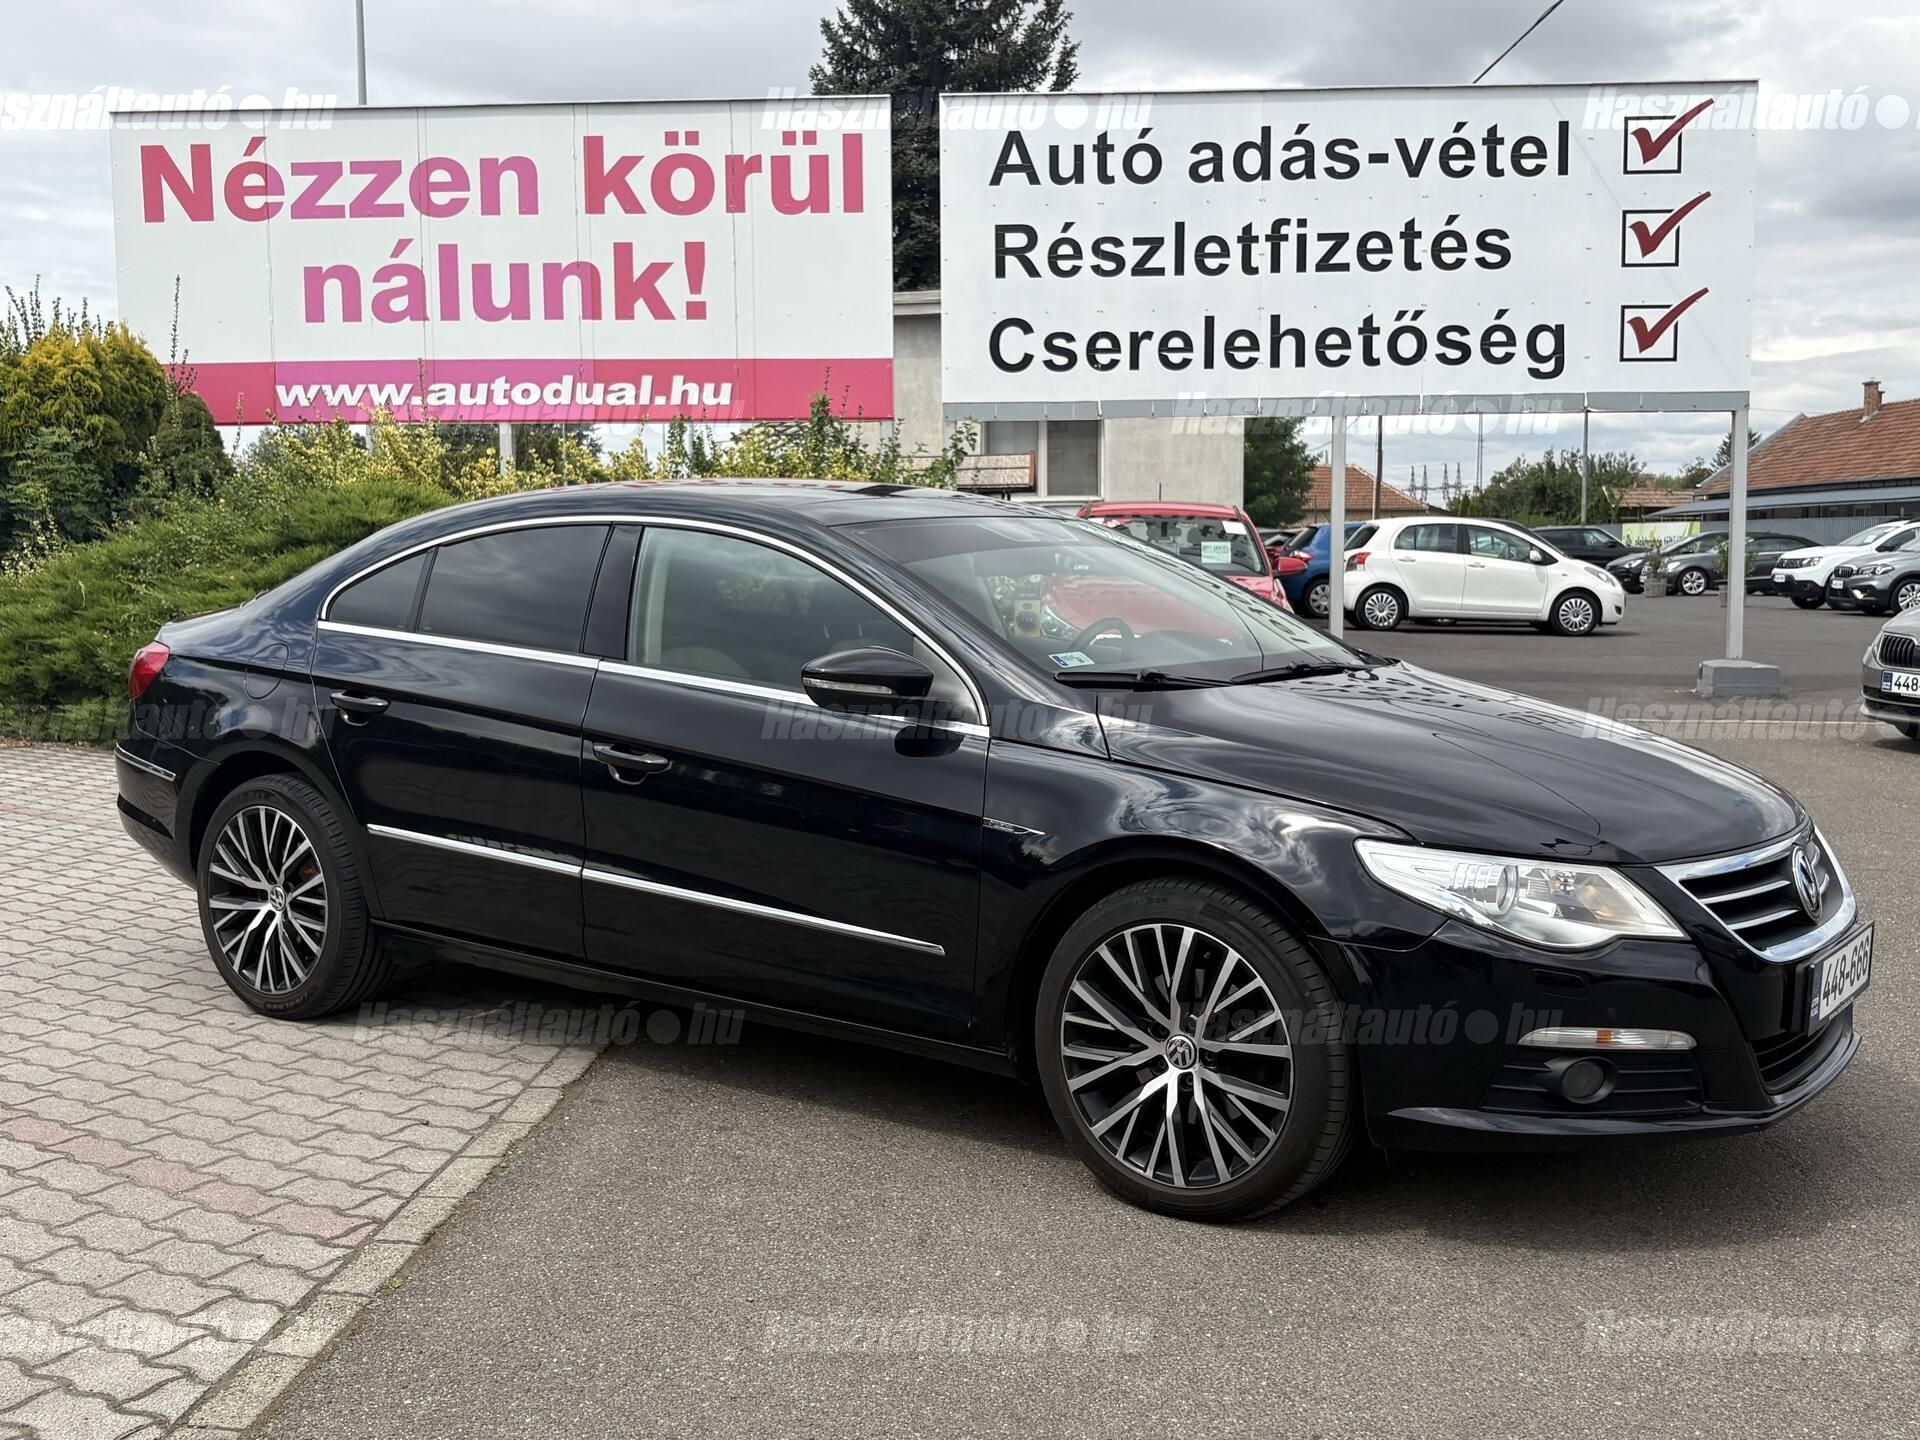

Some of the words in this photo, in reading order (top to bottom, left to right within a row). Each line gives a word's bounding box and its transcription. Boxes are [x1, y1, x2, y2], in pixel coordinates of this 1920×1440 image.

[140, 136, 538, 224] Nézzen
[583, 131, 864, 216] körül
[989, 127, 1163, 187] Autó
[1188, 120, 1570, 184] adás-vétel
[304, 239, 707, 324] nálunk!
[994, 214, 1513, 280] Részletfizetés
[989, 308, 1566, 380] Cserelehetőség
[276, 375, 732, 408] www.autodual.hu
[1822, 935, 1870, 1007] 448-666
